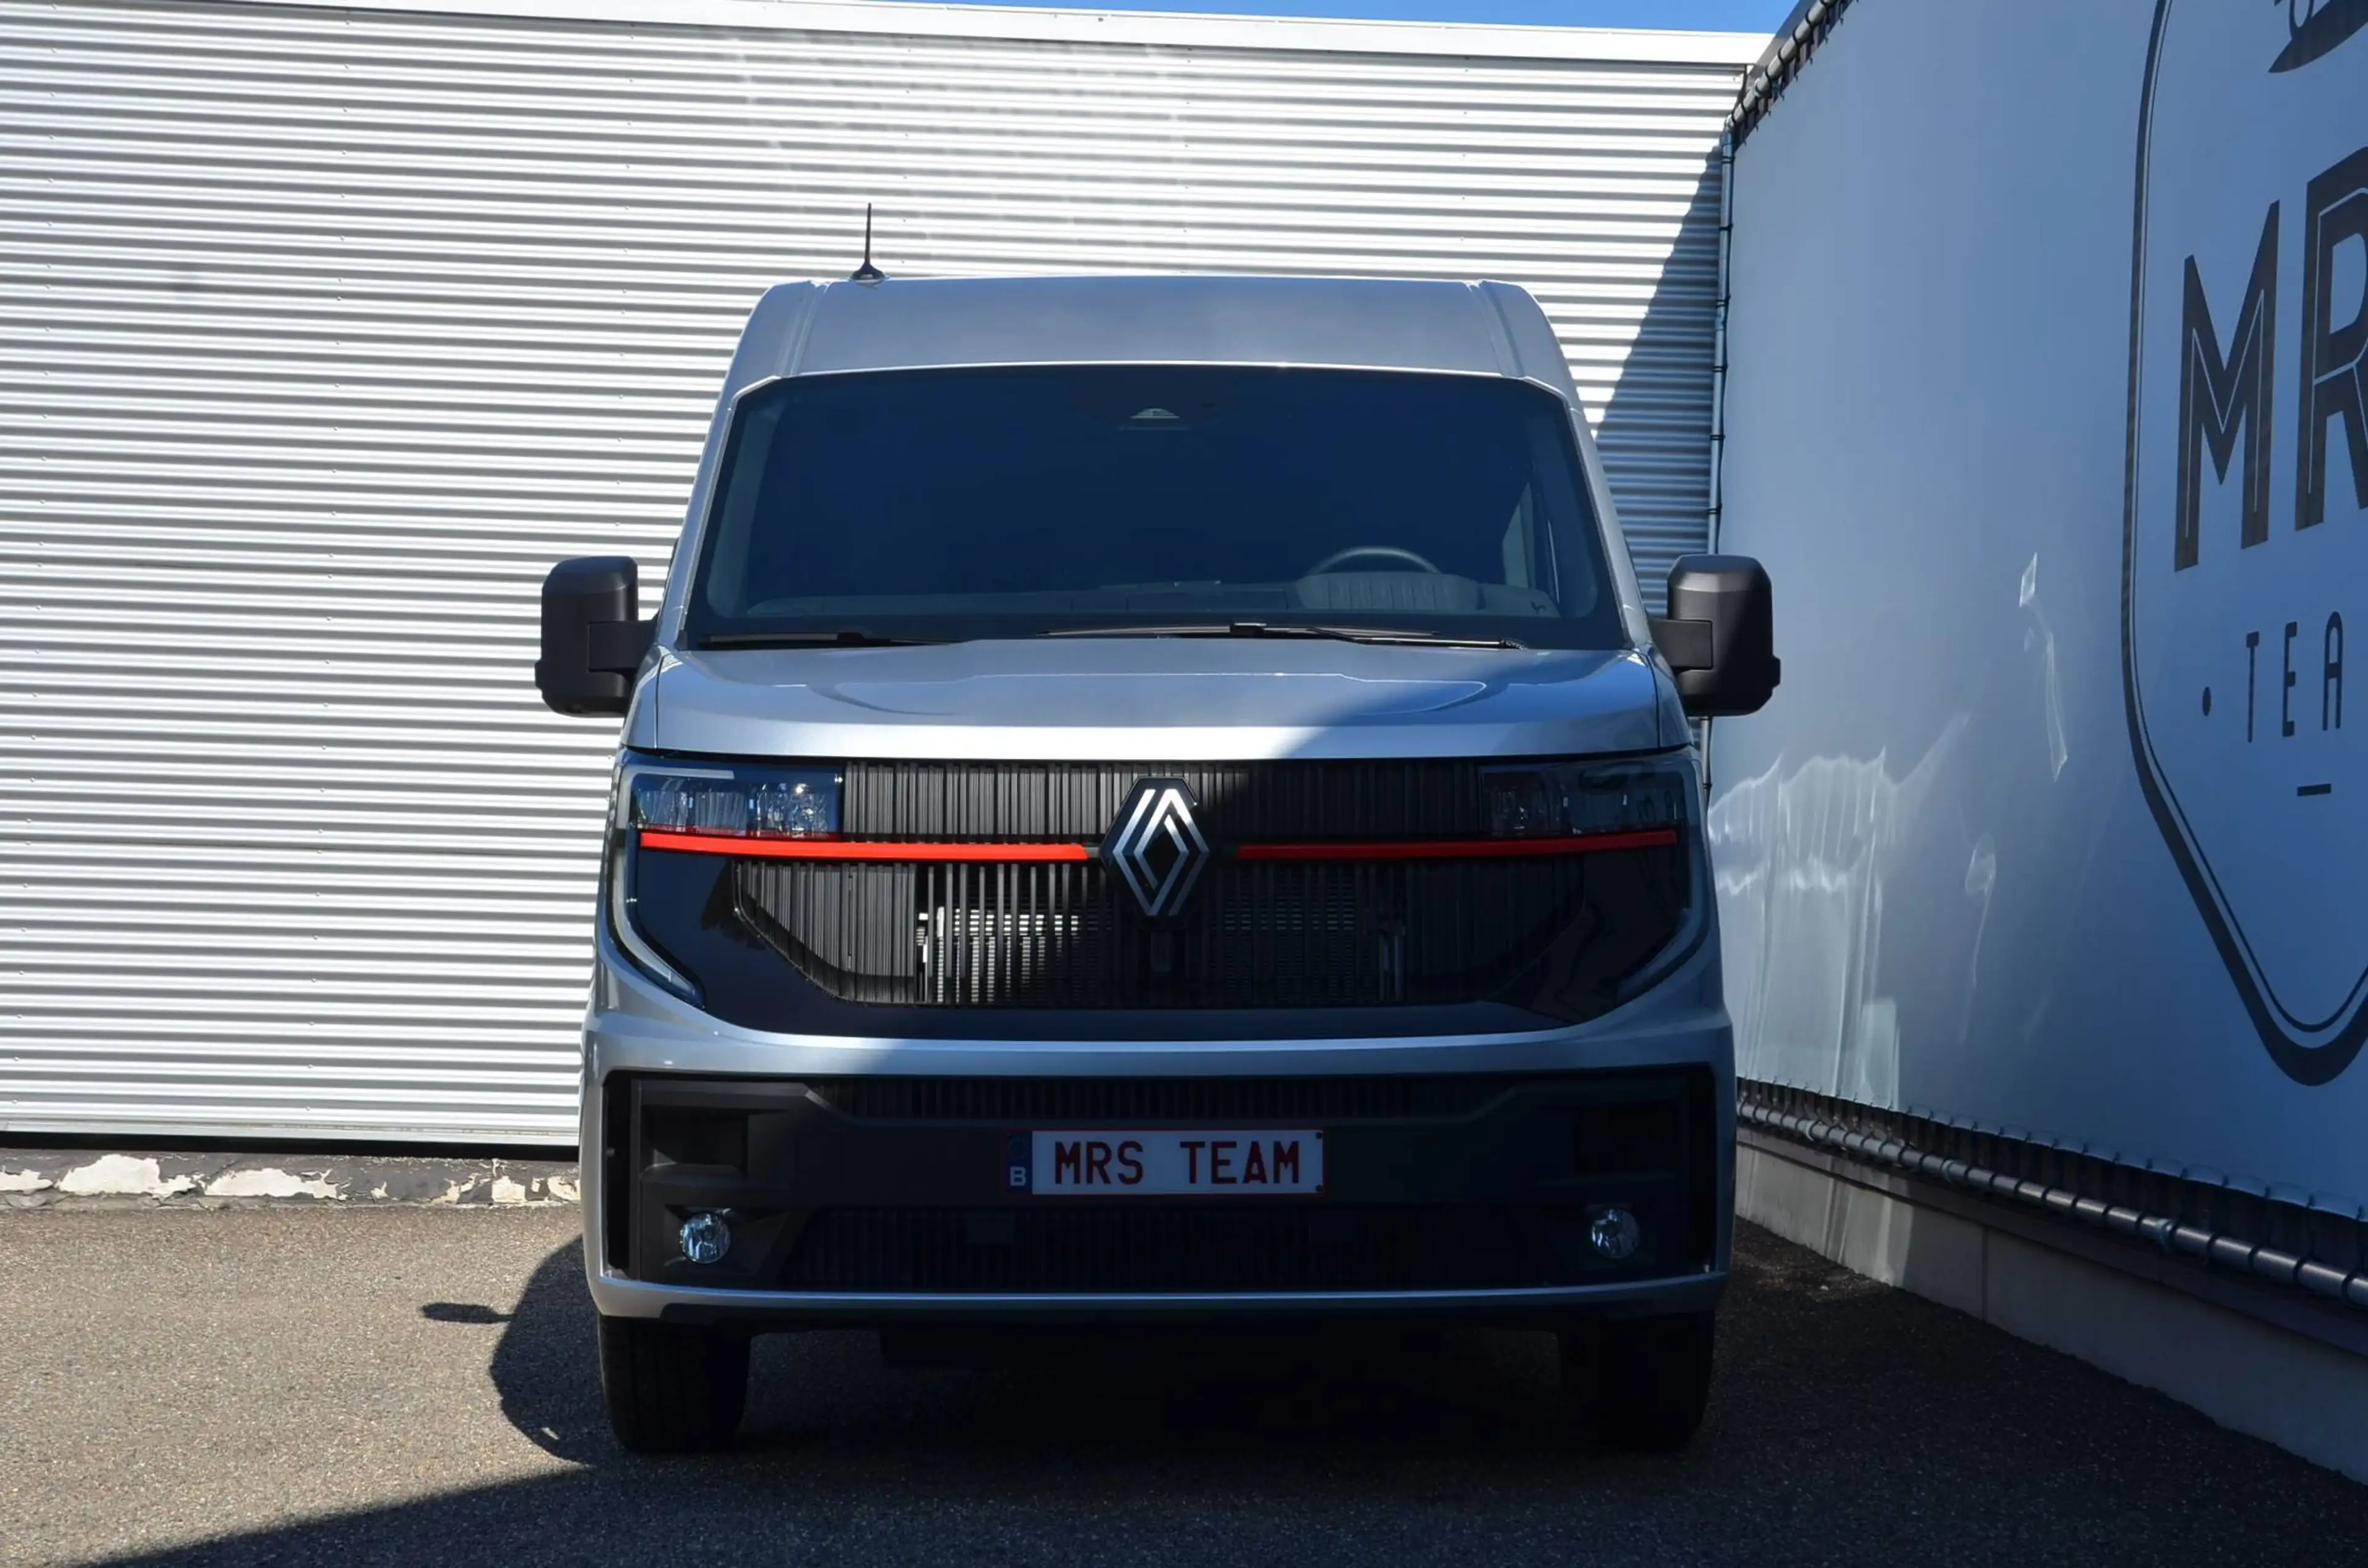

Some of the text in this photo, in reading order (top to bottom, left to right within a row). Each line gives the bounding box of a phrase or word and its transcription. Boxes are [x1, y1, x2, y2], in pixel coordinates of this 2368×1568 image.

[2246, 611, 2343, 742] TEA
[1009, 1166, 1027, 1186] B
[1054, 1141, 1300, 1184] MRS TEAM
